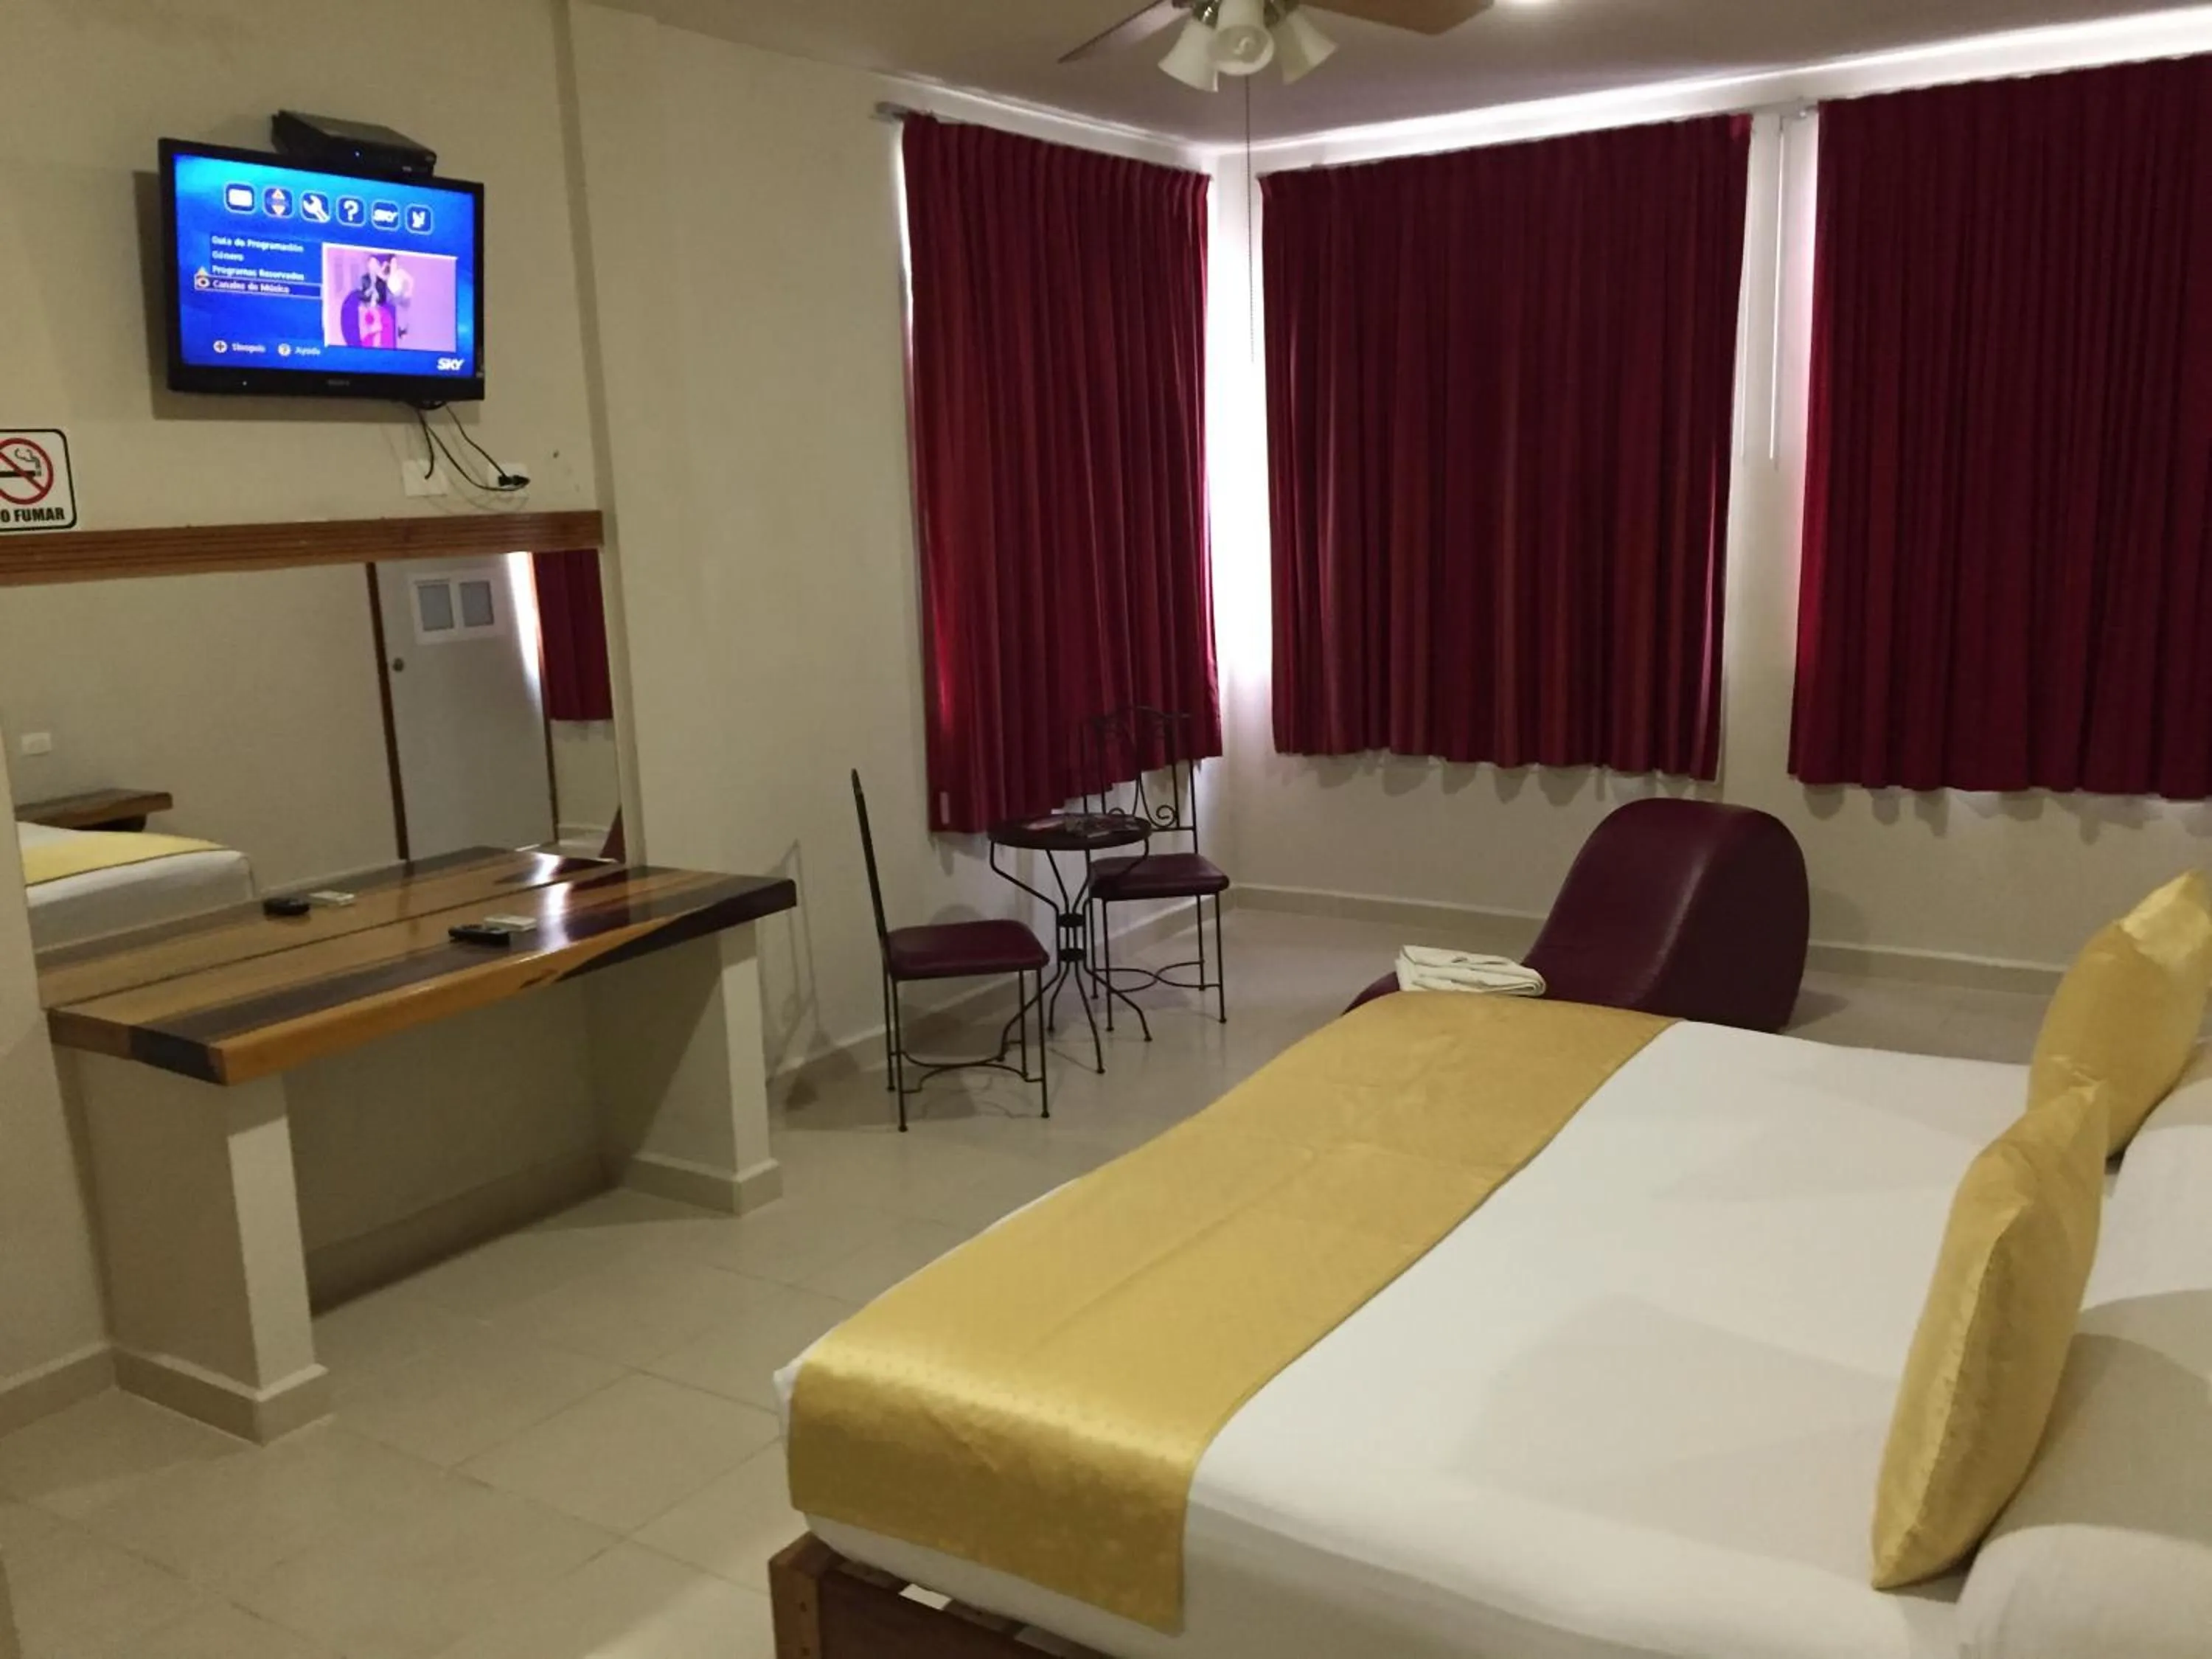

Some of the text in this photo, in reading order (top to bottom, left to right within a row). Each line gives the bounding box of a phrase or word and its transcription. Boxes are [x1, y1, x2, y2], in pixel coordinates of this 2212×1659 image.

[212, 250, 244, 262] Género
[212, 265, 305, 281] Programas Reservados
[212, 279, 246, 291] Canales
[437, 358, 465, 371] SKY
[14, 507, 65, 523] FUMAR
